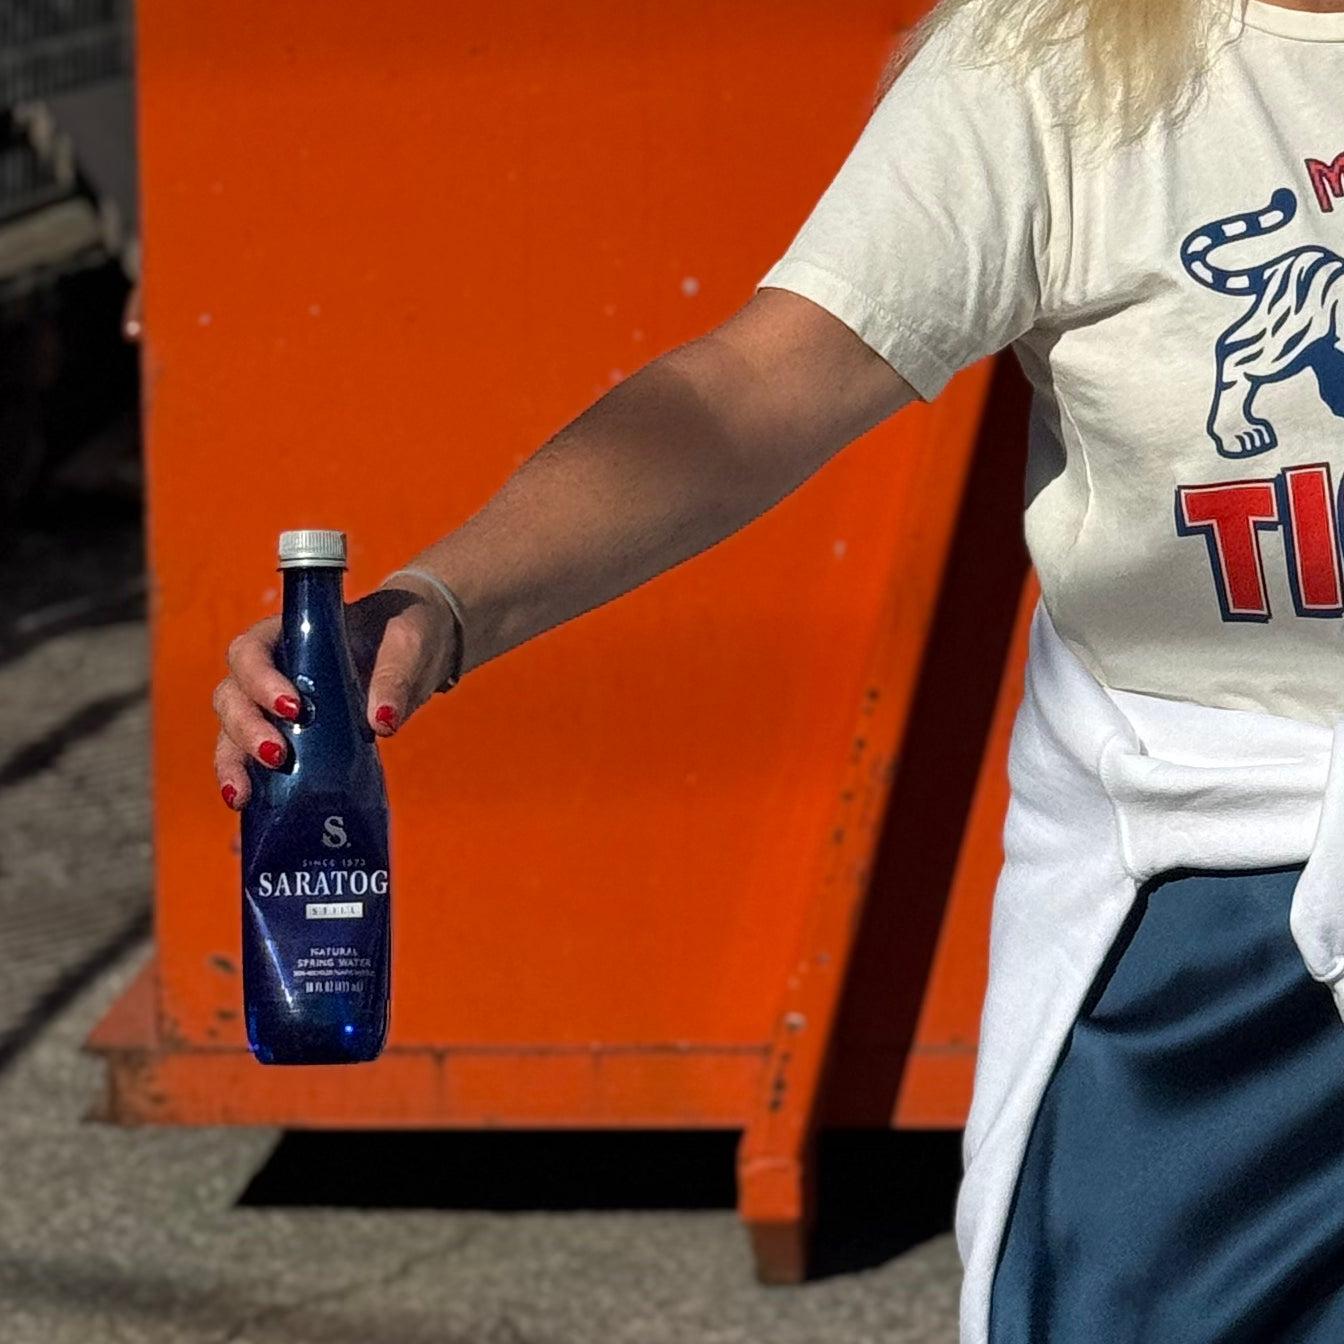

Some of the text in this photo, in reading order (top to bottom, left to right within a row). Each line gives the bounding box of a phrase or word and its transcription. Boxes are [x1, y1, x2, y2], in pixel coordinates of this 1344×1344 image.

[310, 947, 358, 957] NATURAL
[297, 958, 371, 968] SPRING WATER
